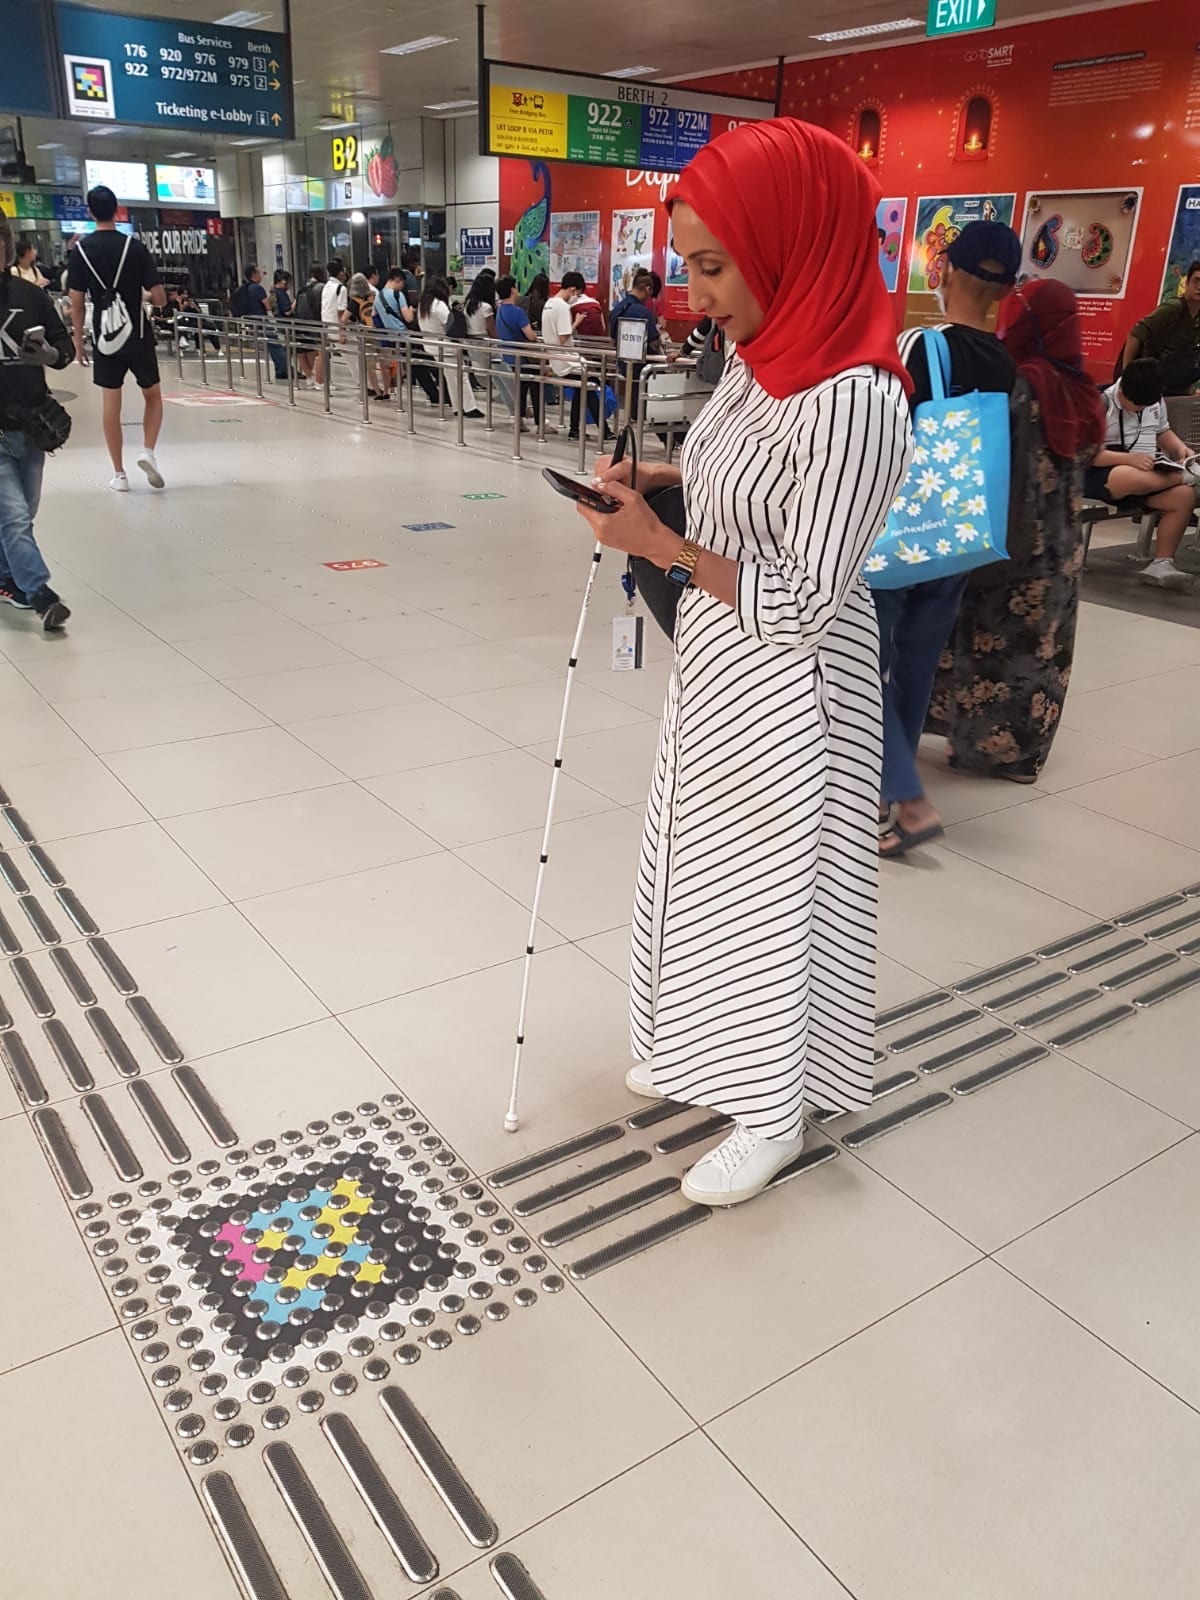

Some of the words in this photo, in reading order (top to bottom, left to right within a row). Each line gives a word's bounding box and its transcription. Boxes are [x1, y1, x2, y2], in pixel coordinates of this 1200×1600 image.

[178, 32, 195, 44] Bus
[197, 35, 233, 49] Services
[247, 42, 271, 54] Berth
[987, 44, 1014, 59] SMRT
[124, 43, 148, 58] 176
[159, 48, 182, 62] 920
[194, 52, 216, 66] 976
[228, 56, 249, 69] 979
[124, 62, 149, 77] 922
[160, 66, 218, 83] 972/972M
[230, 74, 251, 87] 975
[618, 86, 655, 104] BERTH
[660, 92, 668, 106] 2
[155, 102, 208, 121] Ticketing
[210, 109, 253, 125] e-Lobby
[588, 102, 622, 127] 922
[649, 108, 669, 126] 972
[678, 111, 707, 131] 972M
[508, 125, 521, 133] LOOP
[528, 127, 538, 135] VIA
[538, 128, 554, 136] PETIR
[333, 136, 358, 171] B2
[24, 194, 43, 204] 920
[162, 230, 181, 254] OUR
[181, 229, 208, 254] PRIDE
[623, 334, 629, 342] NO
[630, 334, 642, 342] ENTRY
